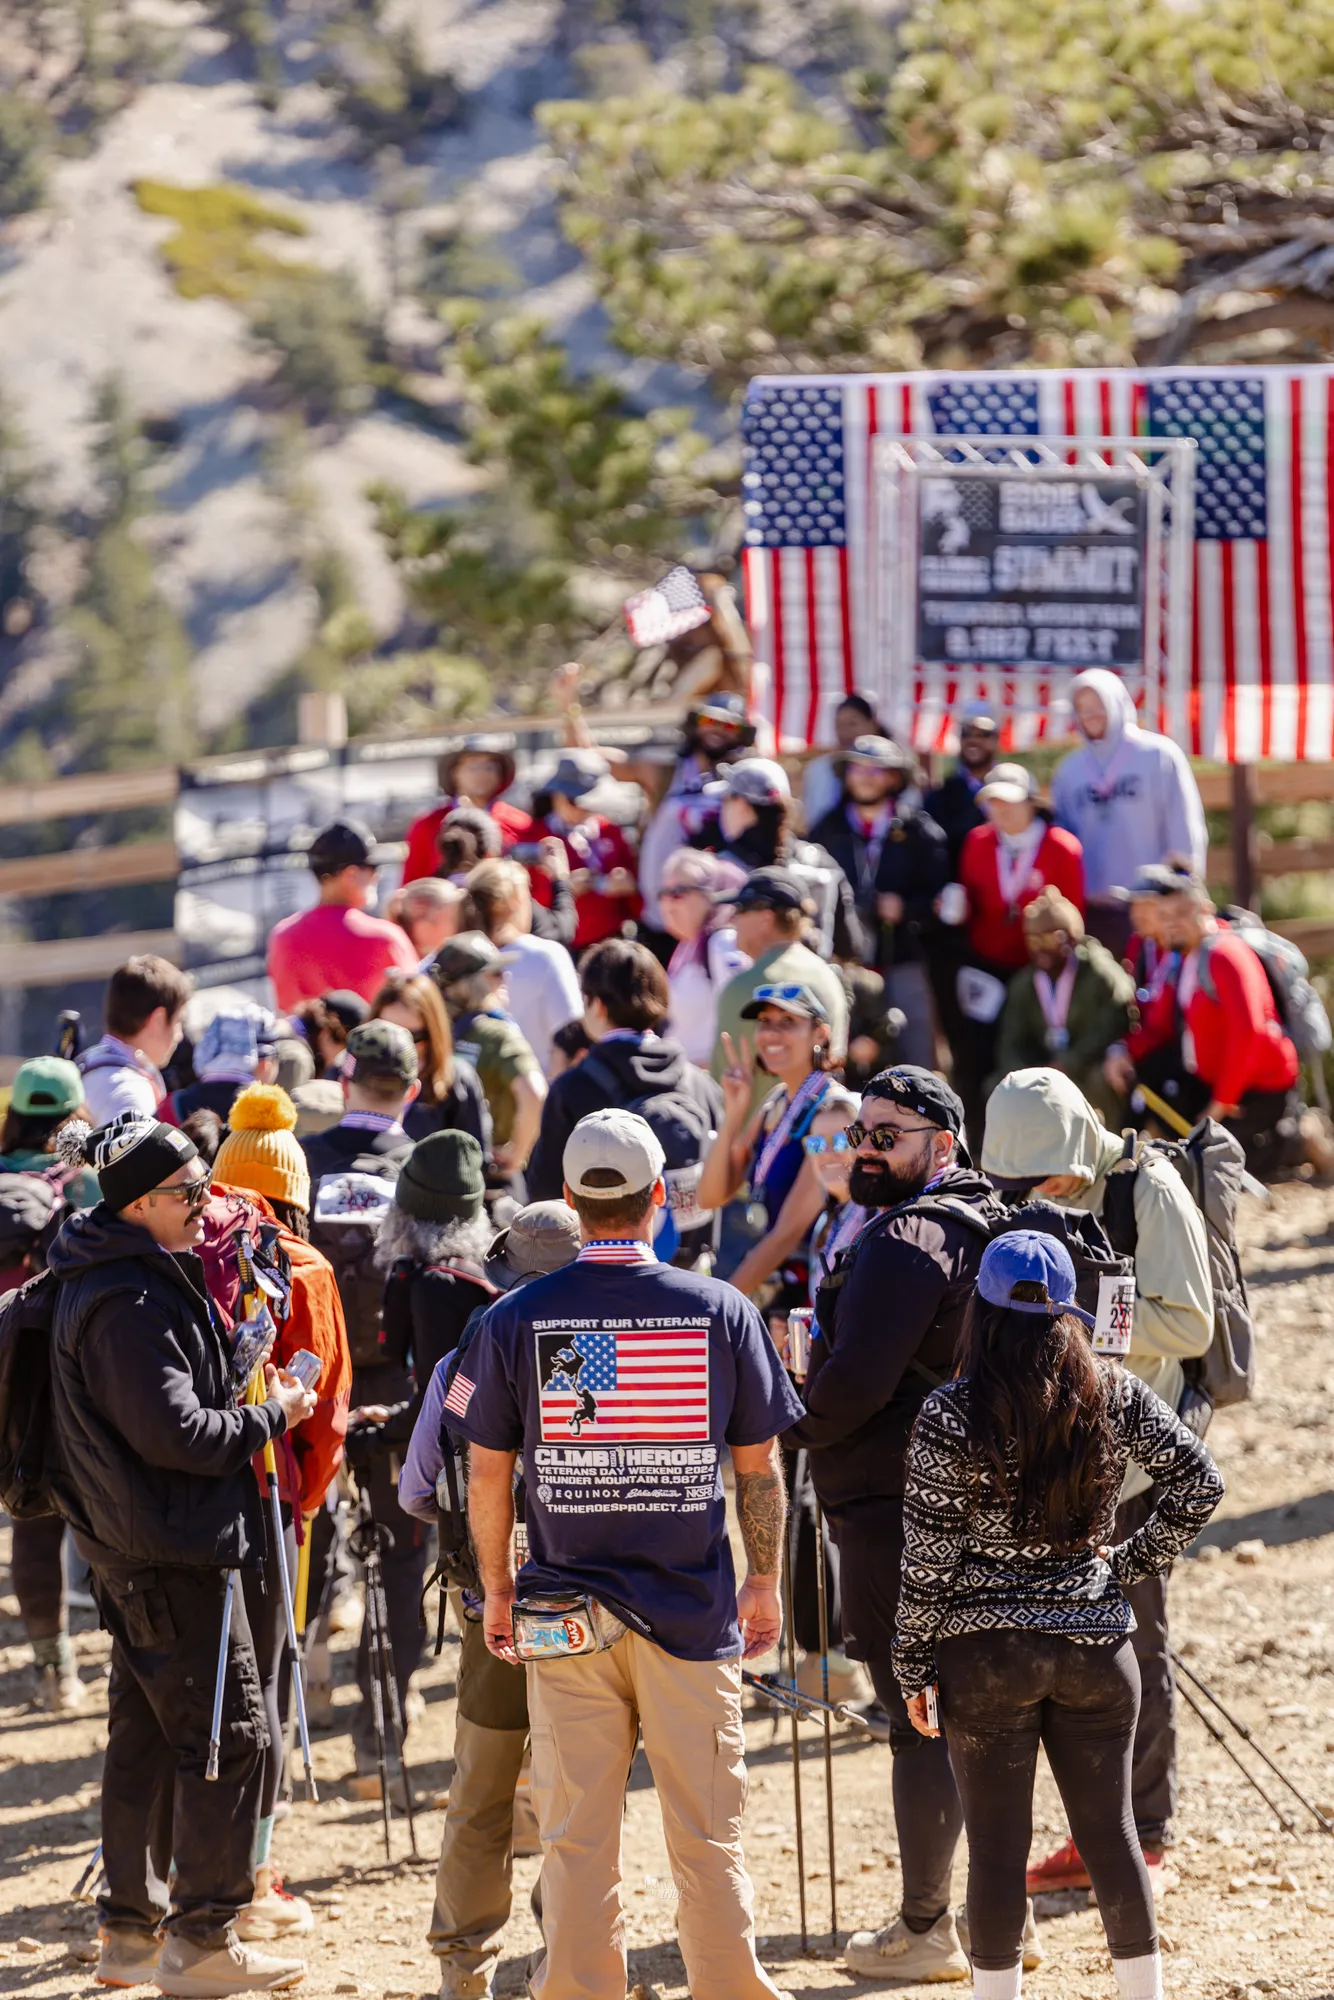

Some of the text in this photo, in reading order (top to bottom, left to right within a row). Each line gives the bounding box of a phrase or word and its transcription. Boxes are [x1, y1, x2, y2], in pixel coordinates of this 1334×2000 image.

[532, 1317, 711, 1330] SUPPORT OUR VETERANS
[535, 1449, 609, 1467] CLIMB
[626, 1448, 716, 1466] HEROES
[537, 1465, 714, 1476] VETERANS DAY WEEKEND 2024
[537, 1475, 592, 1485] THUNDER
[594, 1476, 658, 1485] MOUNTAIN
[555, 1489, 620, 1499] EQUINOX
[545, 1503, 707, 1513] THEHEROESPROJECT.ORG
[567, 1621, 581, 1646] ZYN
